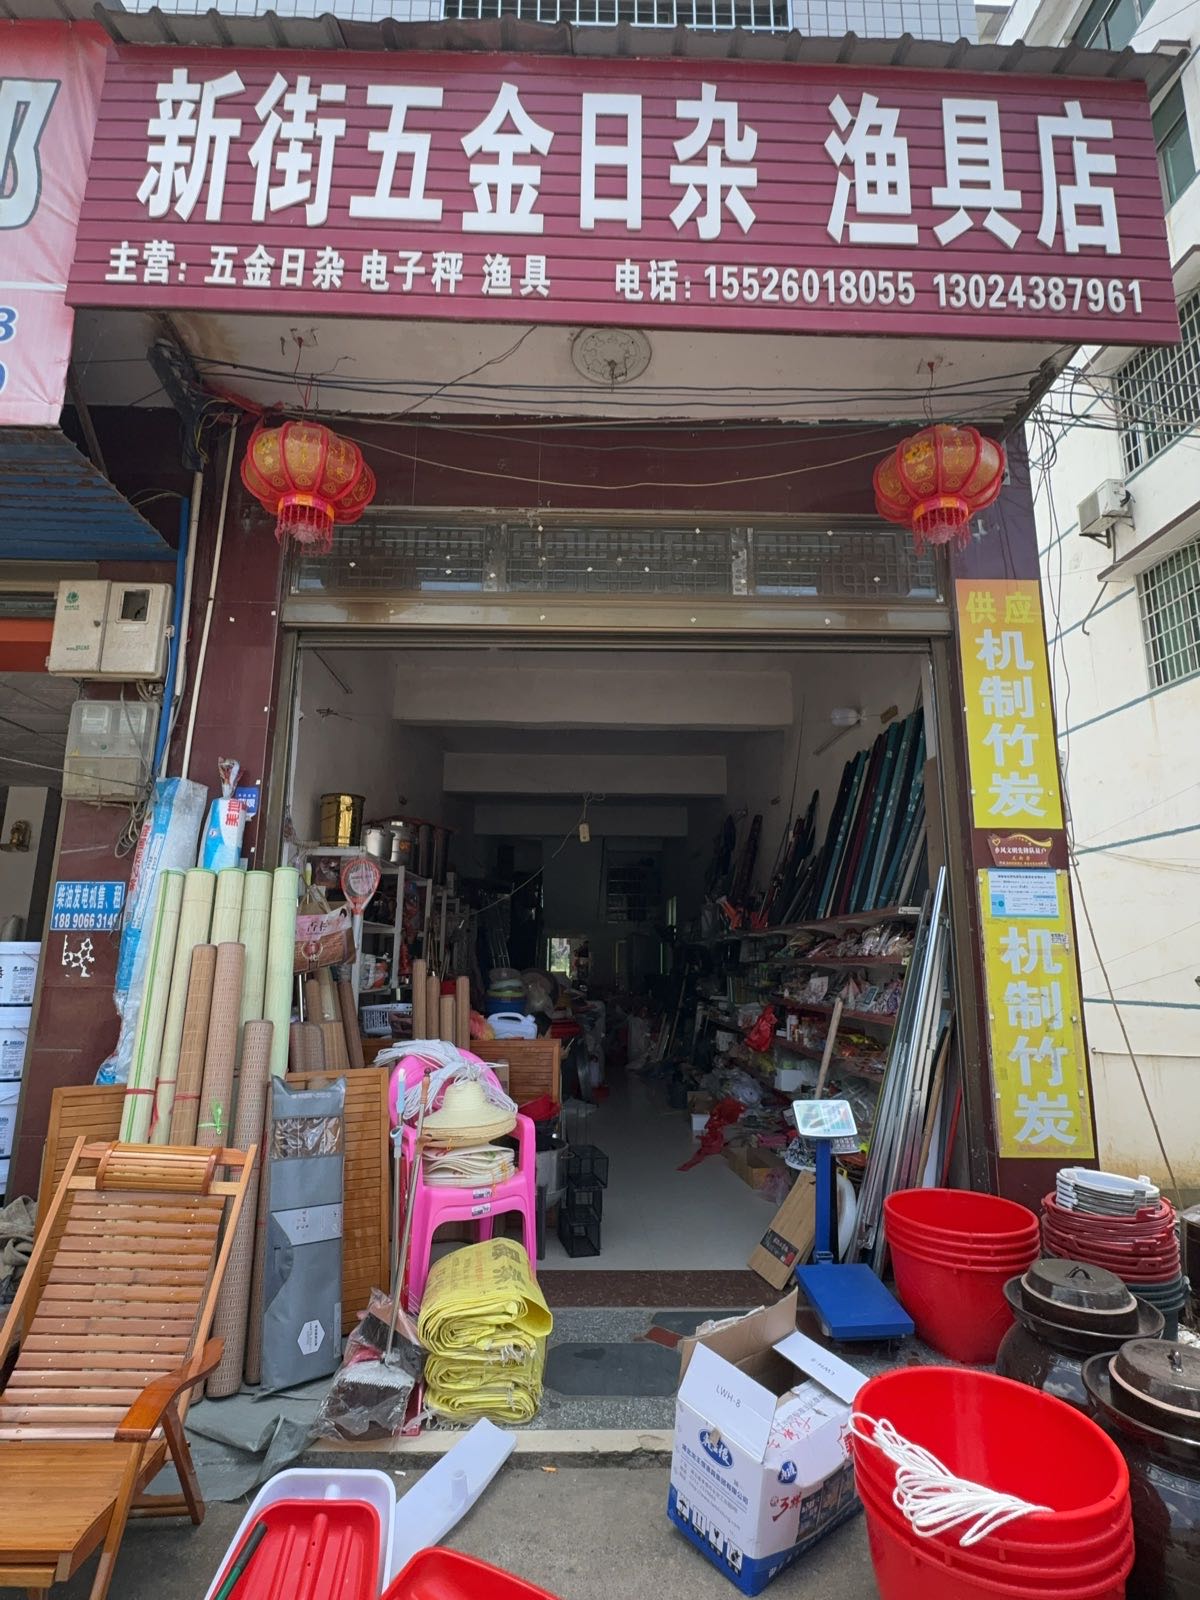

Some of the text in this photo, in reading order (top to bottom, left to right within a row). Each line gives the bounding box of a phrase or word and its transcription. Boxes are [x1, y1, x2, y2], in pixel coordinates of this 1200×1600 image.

[137, 68, 758, 240] 新街五金日杂
[824, 92, 1121, 254] 渔具店
[206, 244, 345, 288] 五金日杂
[361, 249, 463, 293] 电子秤
[481, 254, 551, 297] 渔具
[704, 265, 915, 304] 15526018055
[934, 273, 1142, 313] 13024387961
[965, 591, 1035, 624] 供应
[975, 628, 1047, 817] 机制竹炭
[54, 912, 71, 928] 188
[72, 913, 95, 928] 9066
[1000, 927, 1077, 1146] 机制竹炭
